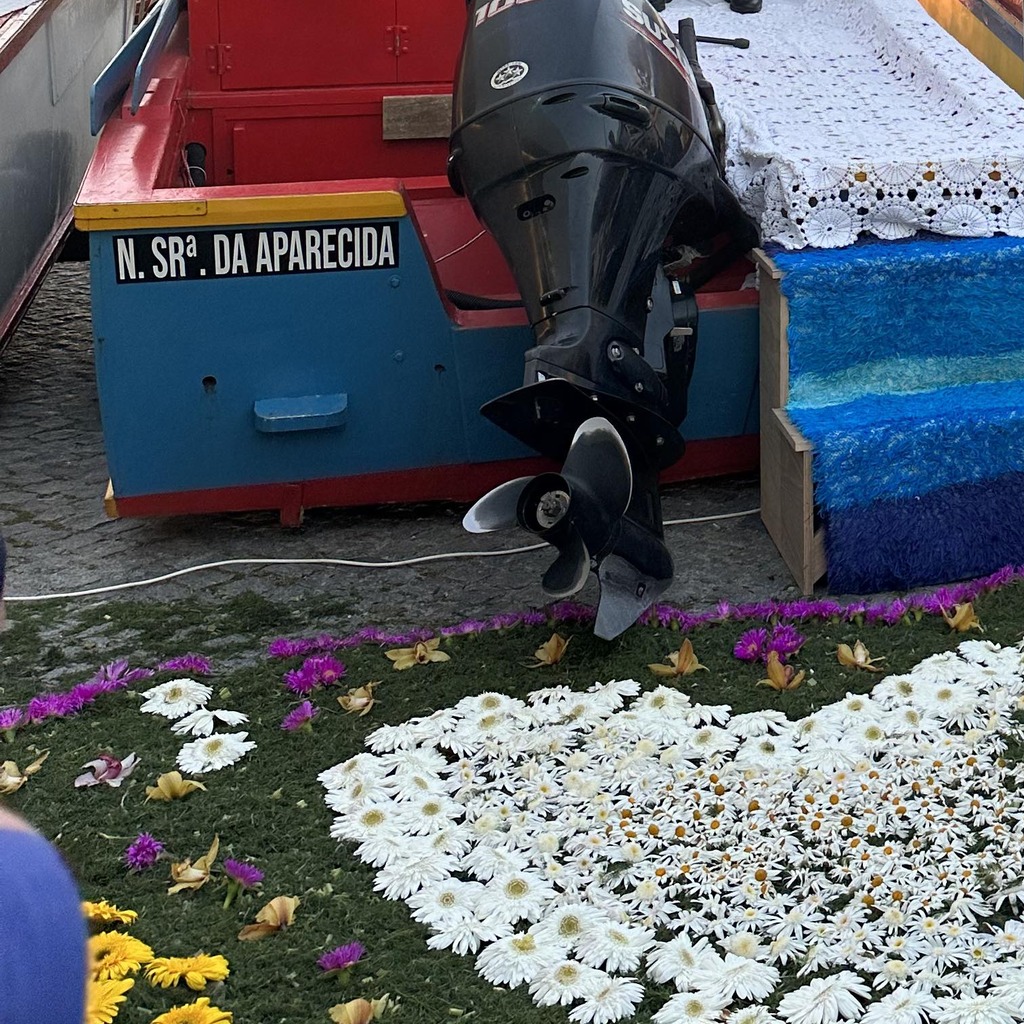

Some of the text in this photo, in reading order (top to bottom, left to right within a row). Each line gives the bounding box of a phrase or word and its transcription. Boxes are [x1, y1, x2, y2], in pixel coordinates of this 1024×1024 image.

[116, 237, 145, 280] N.
[213, 232, 249, 275] DA
[255, 226, 395, 273] APARECIDA
